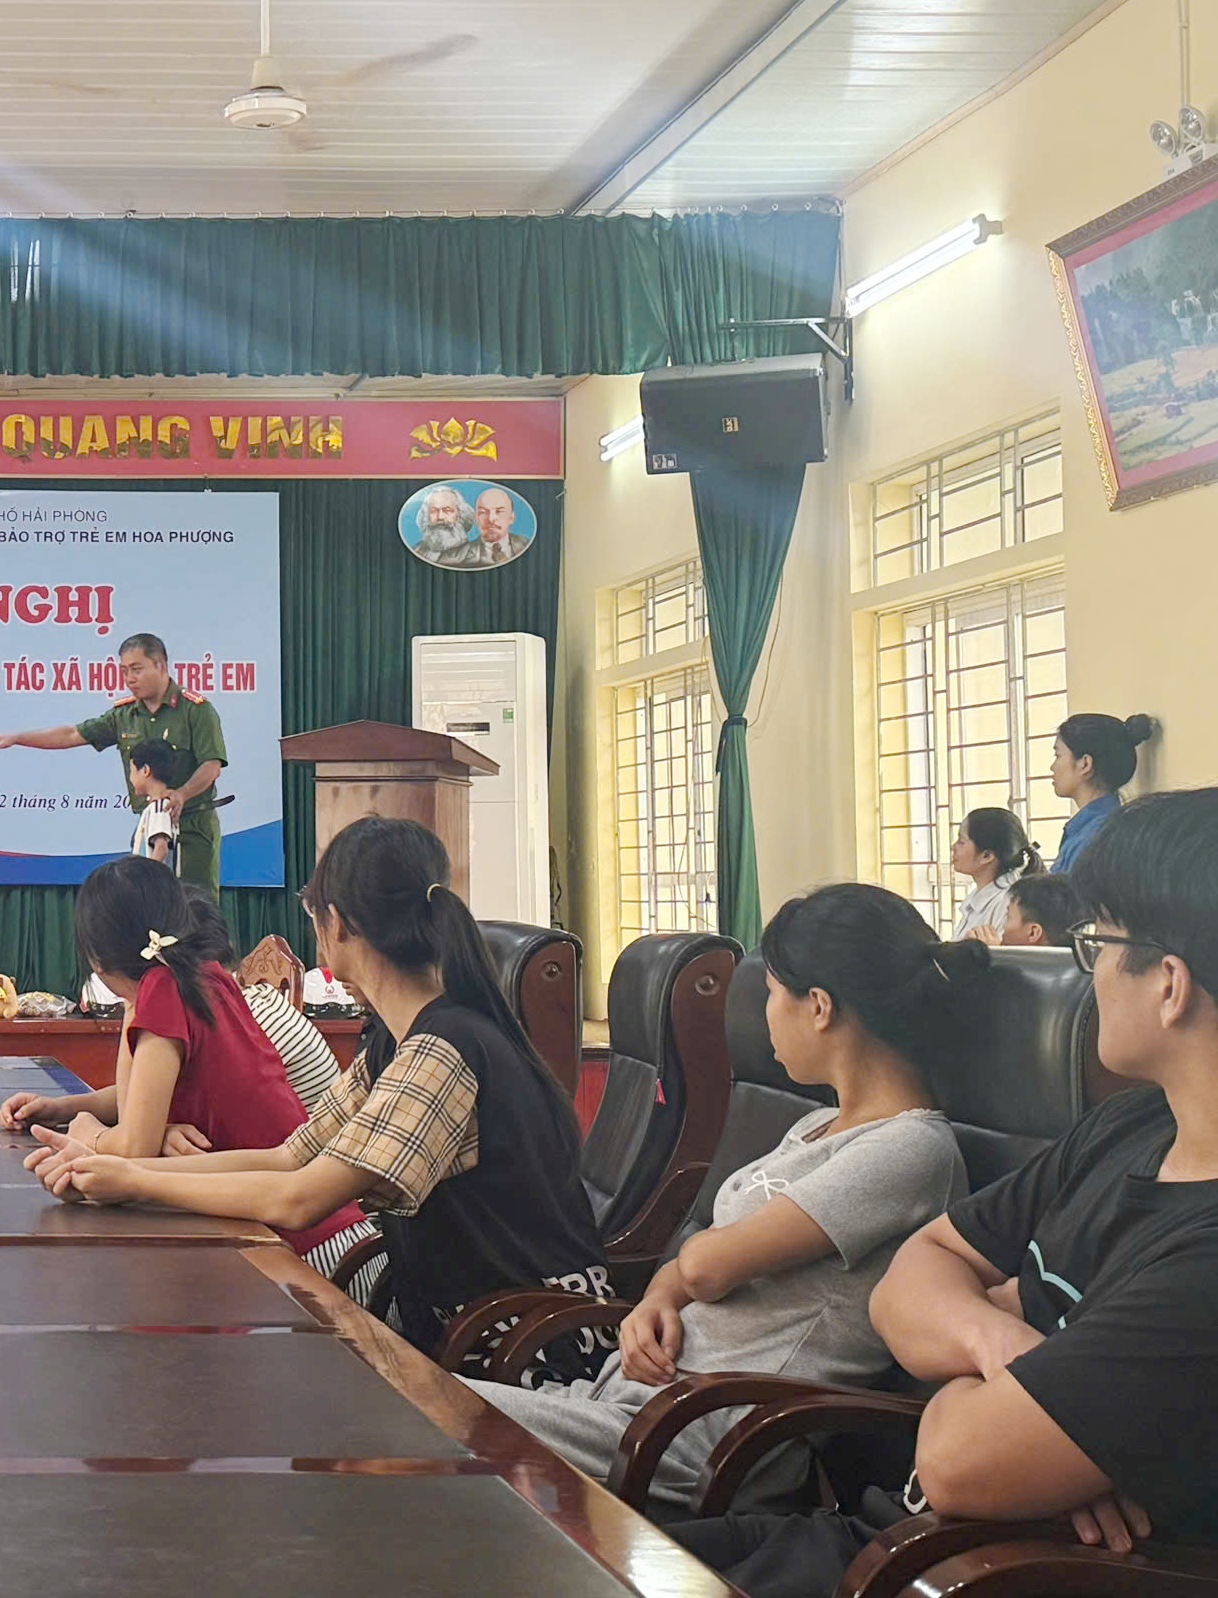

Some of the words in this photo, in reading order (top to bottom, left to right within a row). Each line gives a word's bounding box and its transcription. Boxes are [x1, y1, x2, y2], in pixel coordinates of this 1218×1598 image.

[2, 413, 191, 463] QUANG
[209, 415, 342, 460] VINH
[22, 506, 47, 522] HẢI
[53, 507, 107, 522] PHÒNG
[34, 530, 66, 545] TRỢ
[70, 527, 100, 543] TRẺ
[105, 531, 127, 543] EM
[133, 531, 164, 543] HOA
[169, 530, 234, 545] PHƯỢNG
[4, 657, 46, 691] TÁC
[52, 657, 82, 691] XÃ
[89, 656, 125, 697] HỘI
[174, 652, 214, 691] TRẺ
[222, 663, 255, 691] EM
[12, 794, 57, 812] tháng
[60, 794, 70, 808] 8
[74, 796, 108, 809] năm
[113, 794, 131, 809] 20
